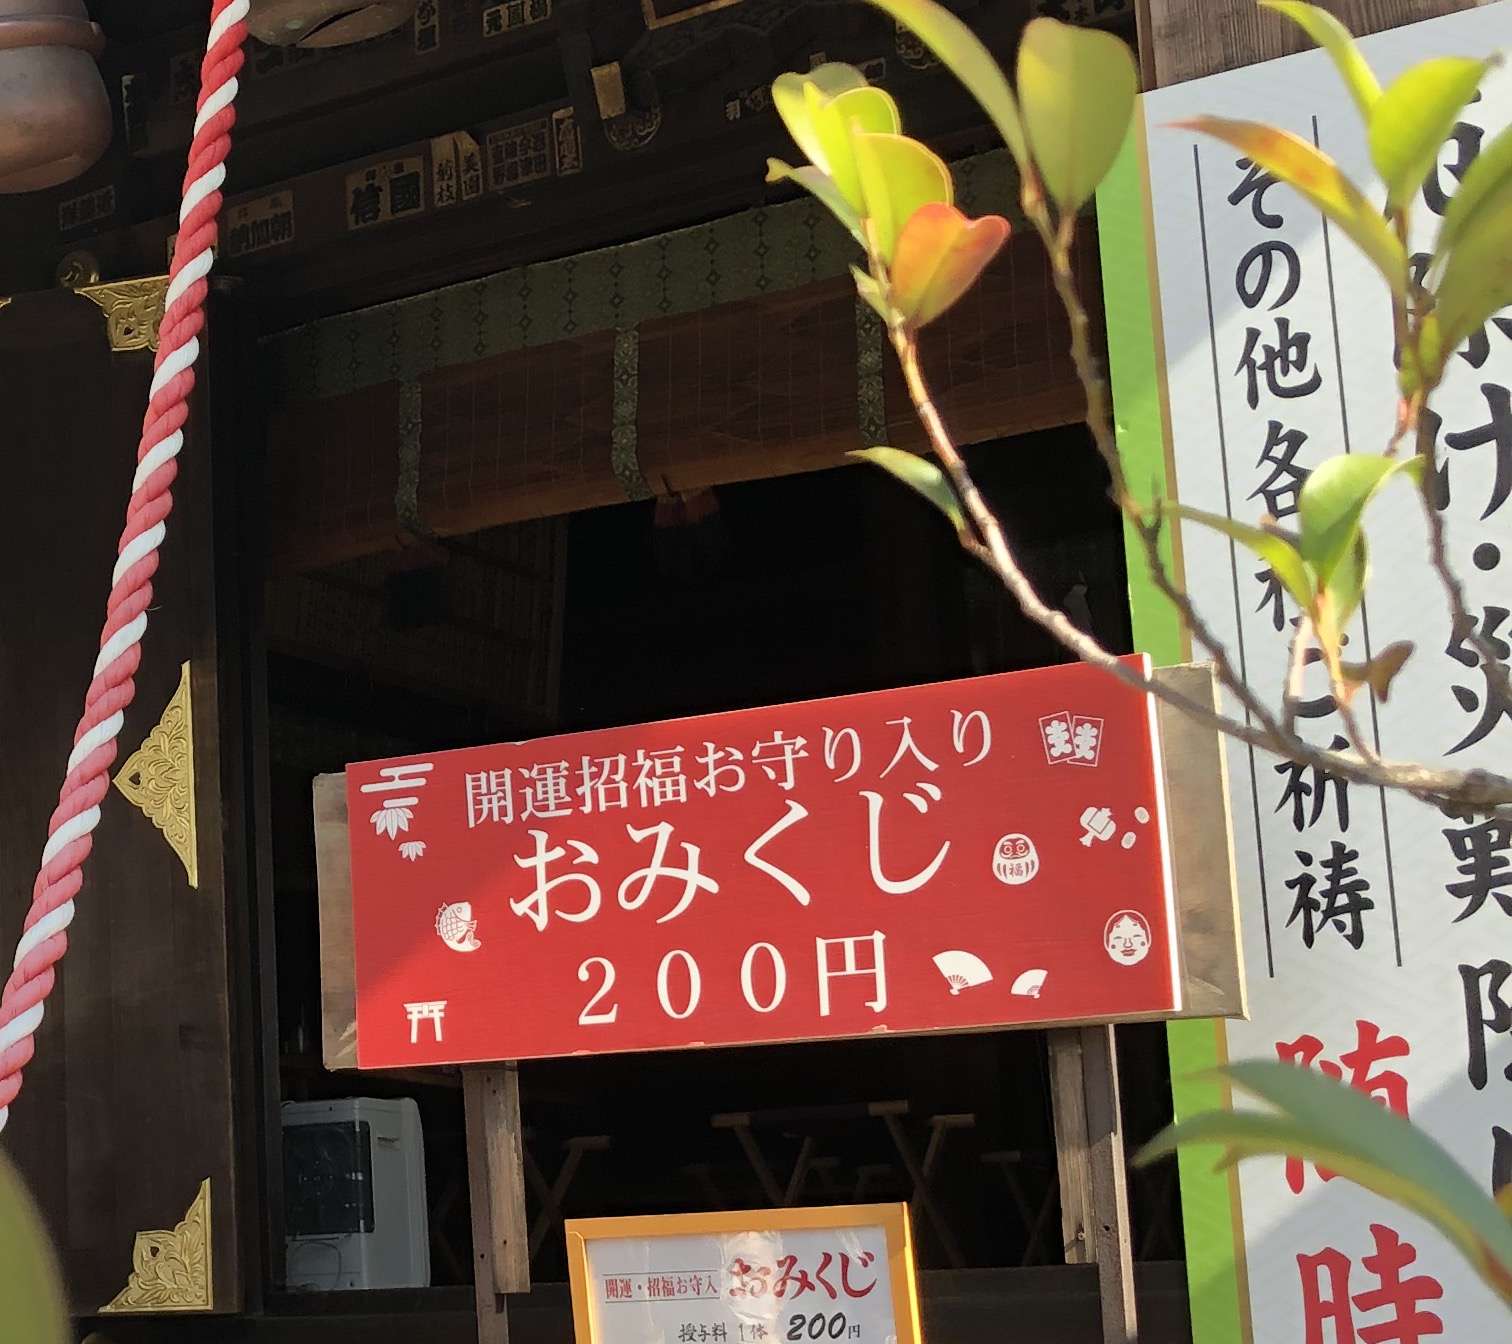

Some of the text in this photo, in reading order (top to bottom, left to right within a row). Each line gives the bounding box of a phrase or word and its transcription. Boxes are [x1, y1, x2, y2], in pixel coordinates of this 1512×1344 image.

[466, 709, 991, 827] 開運招福お守り入り
[510, 783, 951, 932] おみくじ
[728, 1252, 878, 1302] おみくじ
[787, 1312, 861, 1340] 200円
